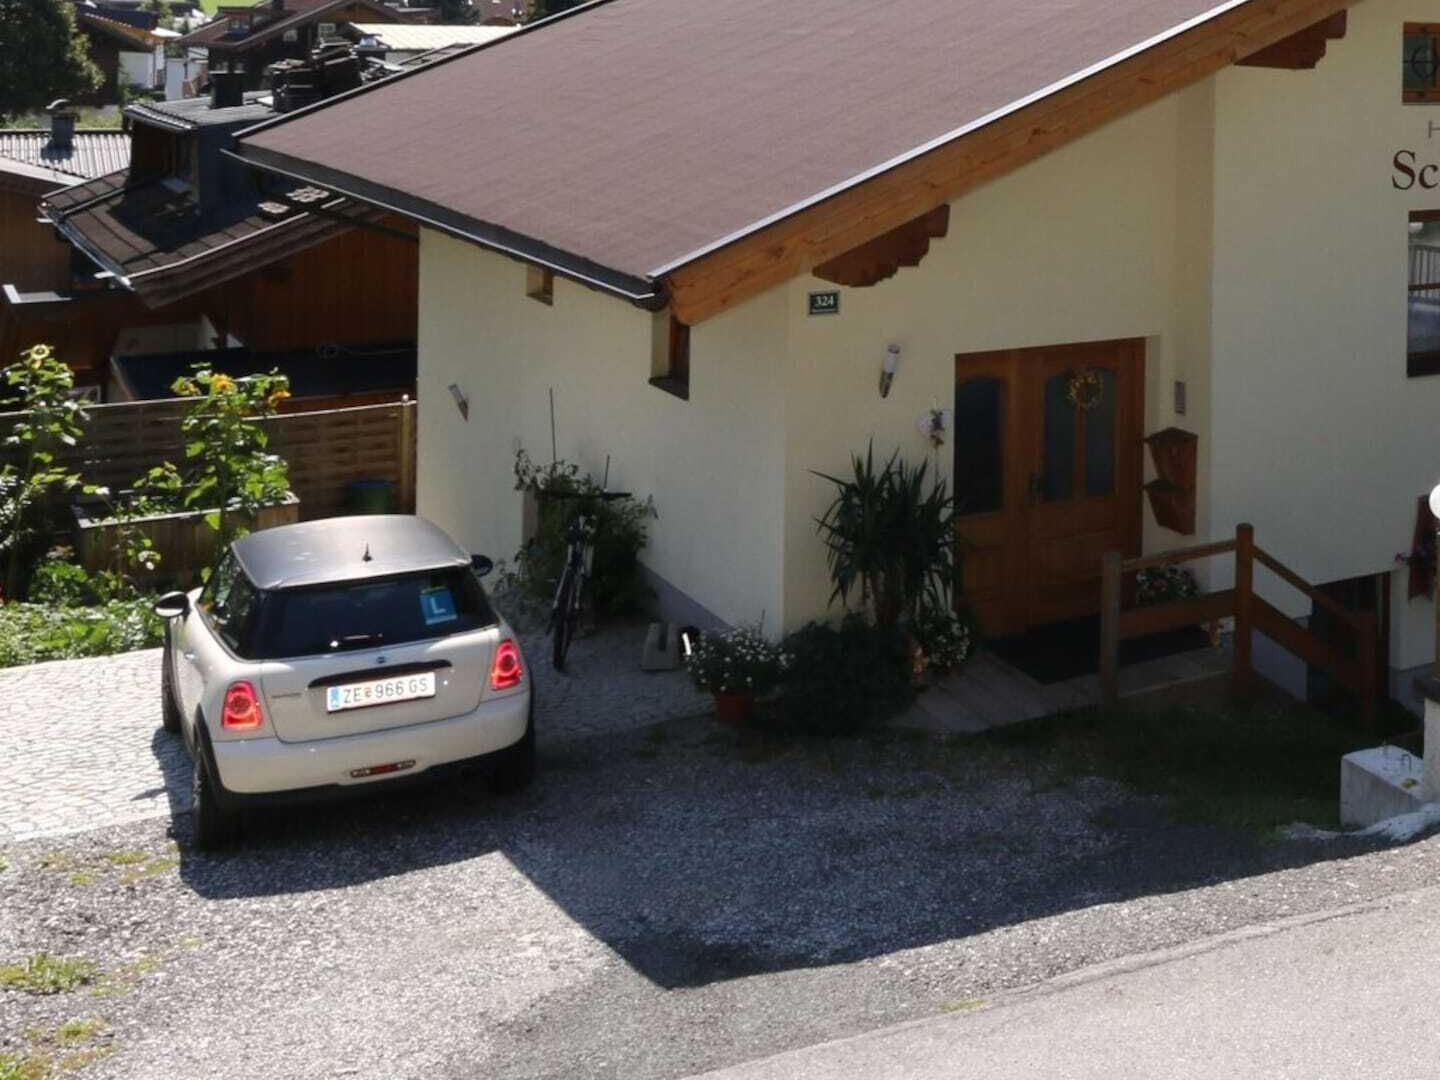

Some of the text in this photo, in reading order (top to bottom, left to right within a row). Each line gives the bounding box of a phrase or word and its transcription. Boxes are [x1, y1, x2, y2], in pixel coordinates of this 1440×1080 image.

[816, 296, 834, 307] 324
[431, 597, 446, 614] L
[343, 688, 361, 704] ZE
[374, 680, 405, 698] 966
